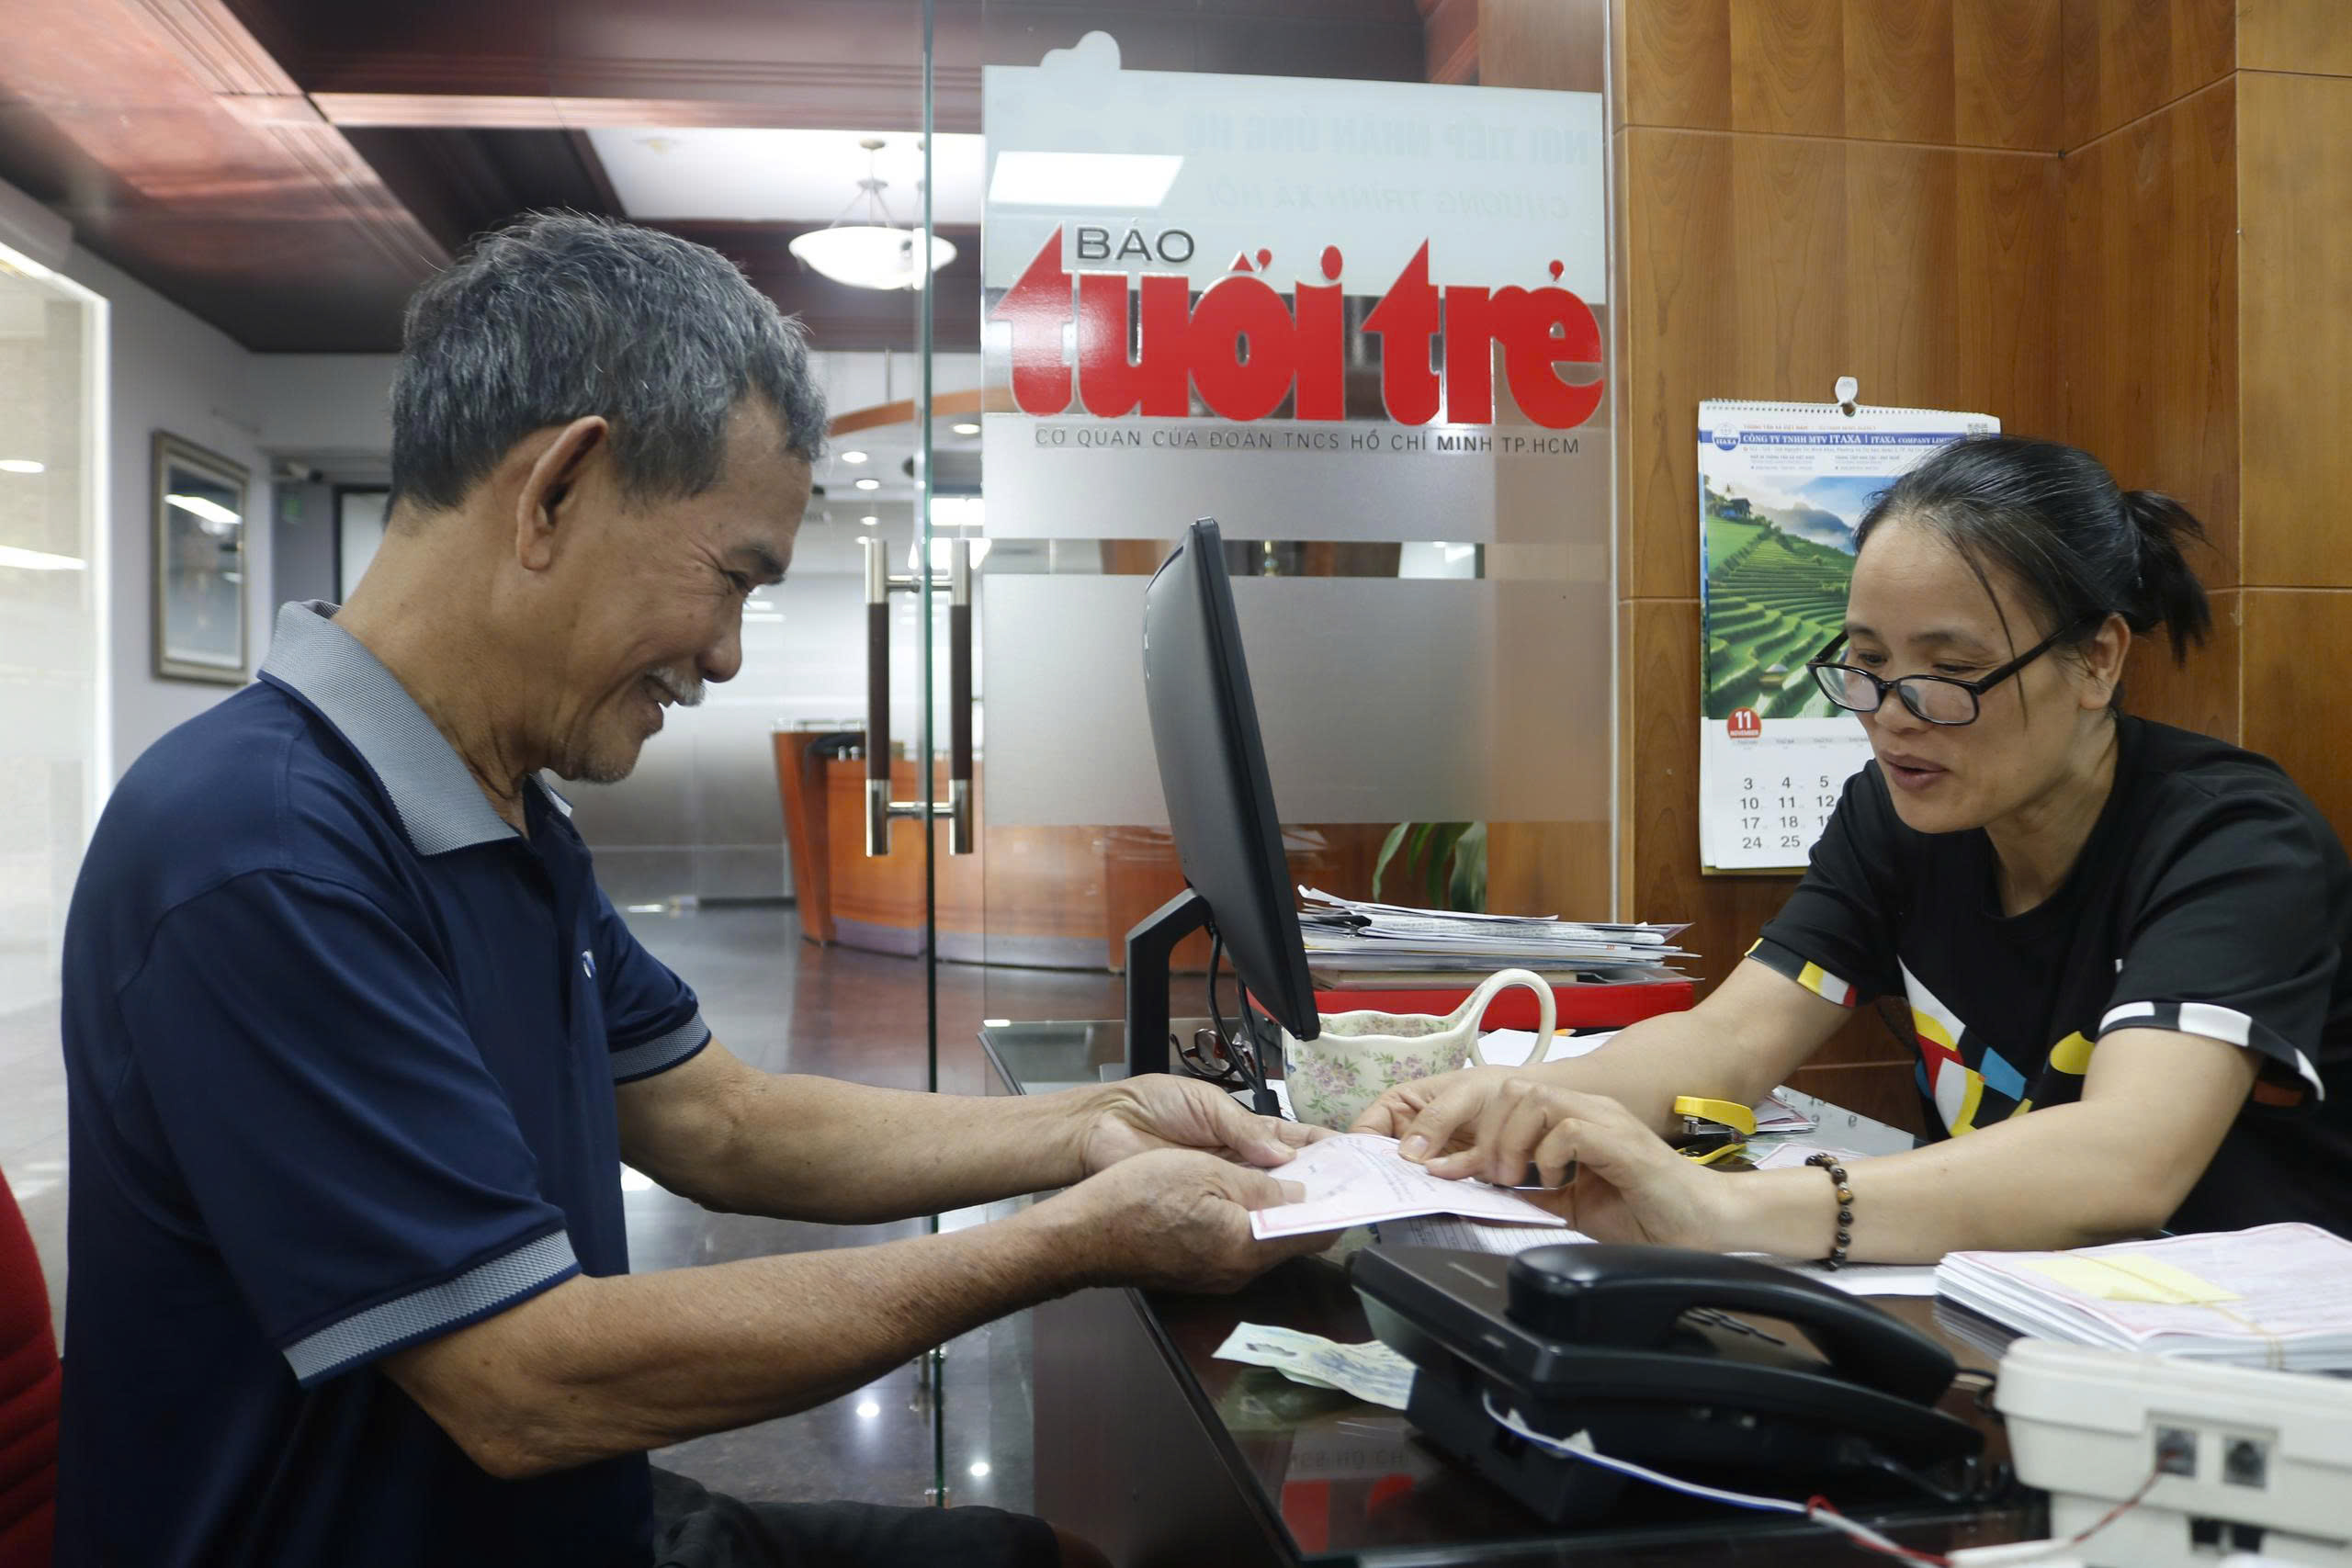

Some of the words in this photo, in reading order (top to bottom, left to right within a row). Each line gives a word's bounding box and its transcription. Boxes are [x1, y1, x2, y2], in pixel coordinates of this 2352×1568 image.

[1077, 429, 1142, 448] QUAN
[1152, 425, 1199, 447] CỦA
[1209, 428, 1273, 448] ĐOÀN
[1285, 432, 1340, 449] TNCS
[1390, 429, 1426, 451] CHÍ
[1437, 435, 1492, 452] MINH
[1501, 436, 1579, 454] TP.HCM
[1743, 434, 1768, 444] CÔNG
[1770, 435, 1780, 444] TY
[1782, 435, 1807, 444] TNHH
[1808, 435, 1827, 444] MTV
[1829, 434, 1861, 445] ITAXA
[1871, 435, 1896, 444] ITAXA
[1735, 710, 1752, 728] 11
[1744, 777, 1753, 790] 3
[1781, 776, 1792, 789] 4
[1820, 775, 1829, 788] 5
[1740, 797, 1759, 809] 10
[1779, 796, 1795, 808] 11
[1816, 795, 1835, 807] 12
[1742, 817, 1760, 829] 17
[1781, 816, 1798, 828] 18
[1743, 837, 1762, 850] 24
[1781, 835, 1801, 848] 25
